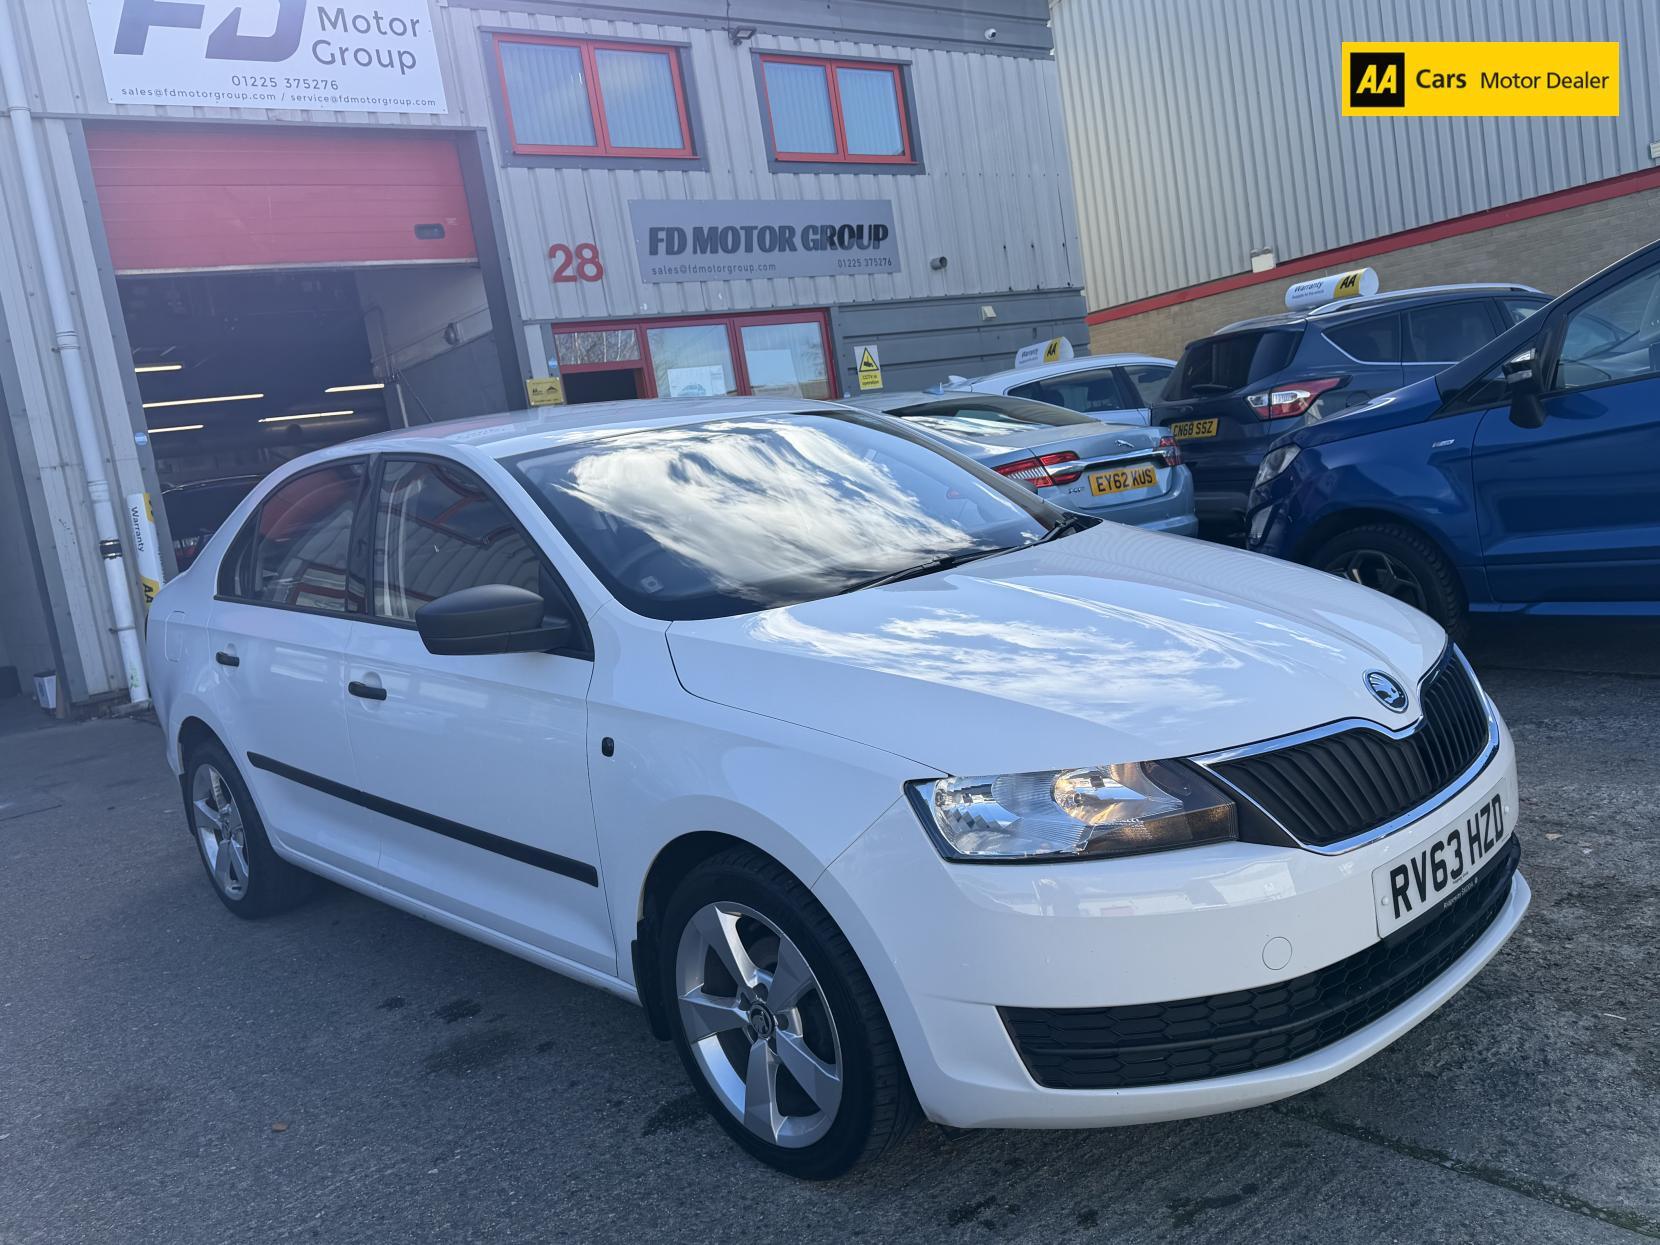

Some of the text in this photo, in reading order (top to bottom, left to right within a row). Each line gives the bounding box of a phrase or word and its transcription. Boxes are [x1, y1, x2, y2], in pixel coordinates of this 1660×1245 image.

[317, 6, 421, 37] Motor
[311, 39, 418, 75] Group
[231, 74, 340, 91] 01225 375276
[121, 86, 277, 102] sales@fdmotorgroup.com
[290, 93, 437, 108] service@fdmotorgroup.com
[648, 223, 889, 256] FD MOTOR GROUP
[548, 243, 605, 283] 28
[651, 256, 893, 276] sales@fdmotorgroup.com 01225 375276
[1340, 273, 1358, 289] AA
[1047, 342, 1058, 357] AA
[1096, 468, 1153, 492] EY62 KUS
[131, 506, 144, 552] Warranty
[142, 583, 154, 604] AA
[1390, 829, 1464, 920] RV63
[1466, 793, 1504, 865] HZD
